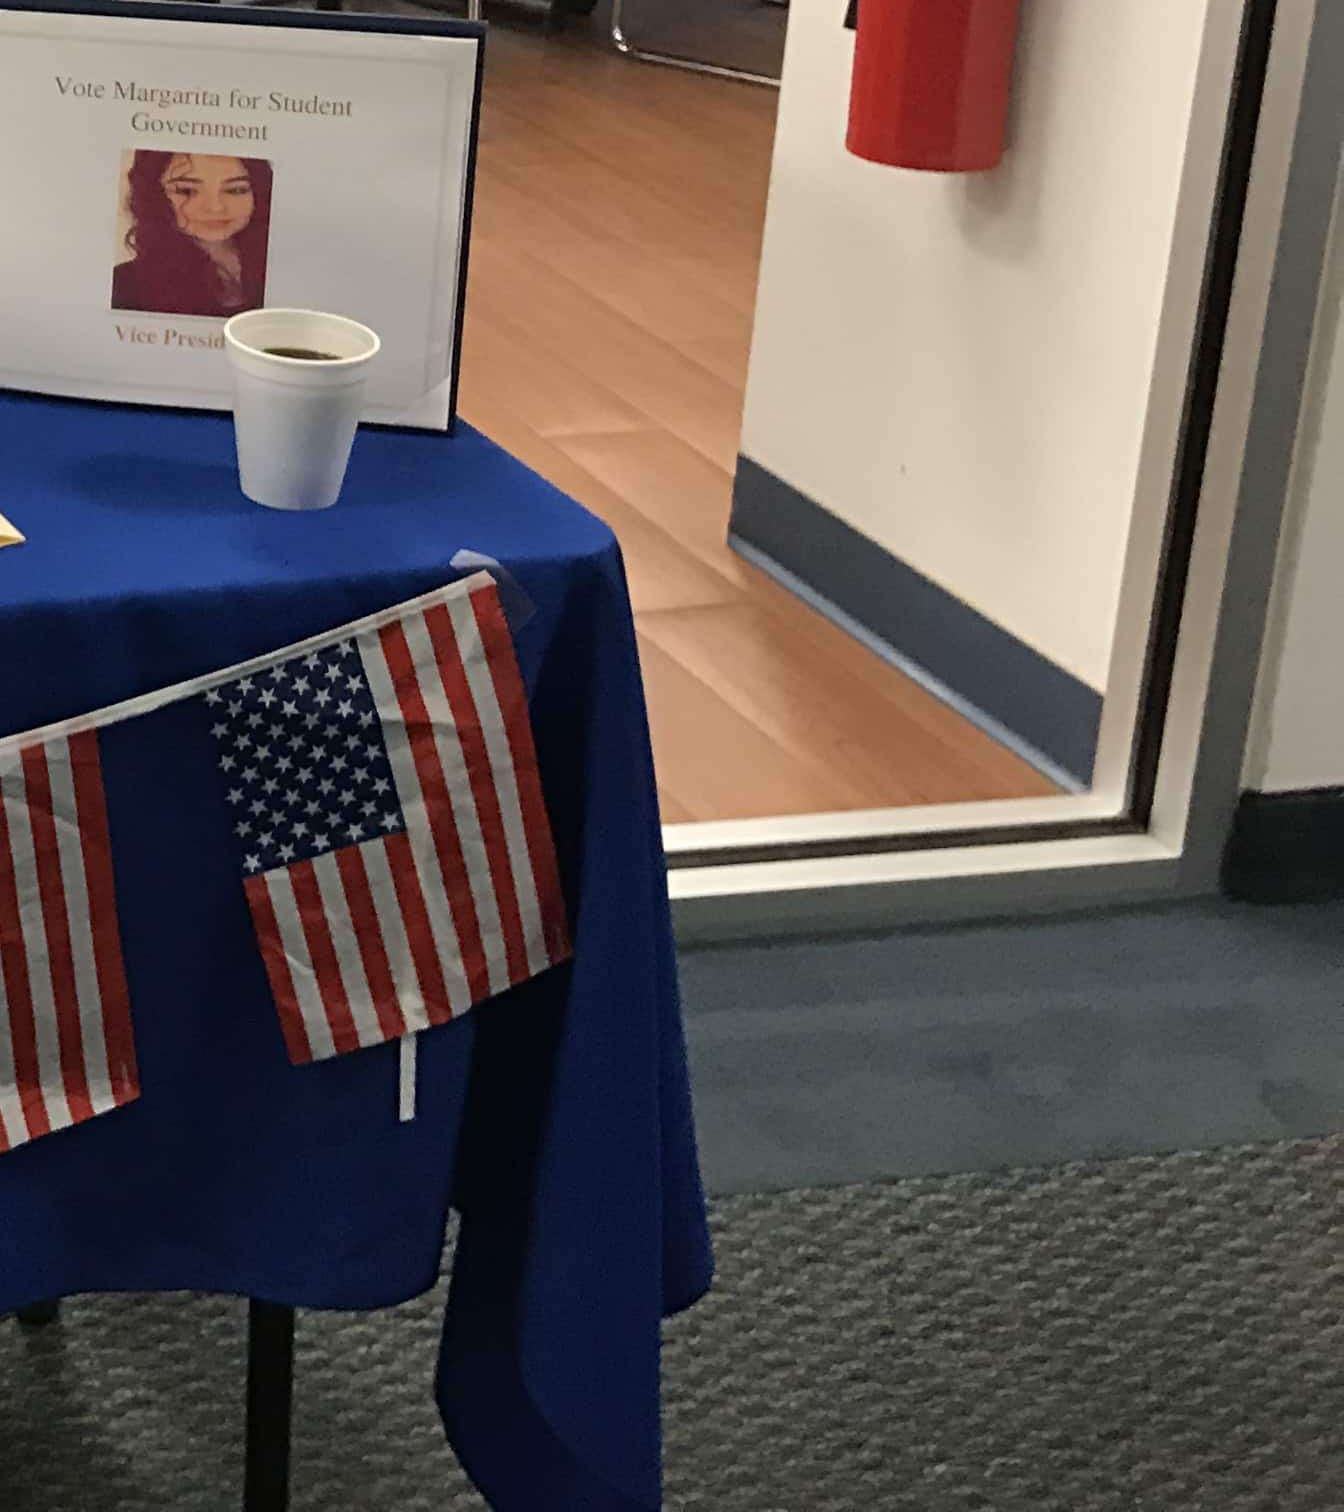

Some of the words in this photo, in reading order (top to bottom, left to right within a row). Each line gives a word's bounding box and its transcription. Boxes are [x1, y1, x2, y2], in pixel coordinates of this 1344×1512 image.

[55, 75, 105, 100] Vote
[112, 80, 221, 110] Margarita
[228, 88, 263, 110] for
[268, 91, 354, 118] Student
[130, 111, 270, 142] Government
[113, 324, 158, 347] Vice
[164, 327, 226, 351] Presid
